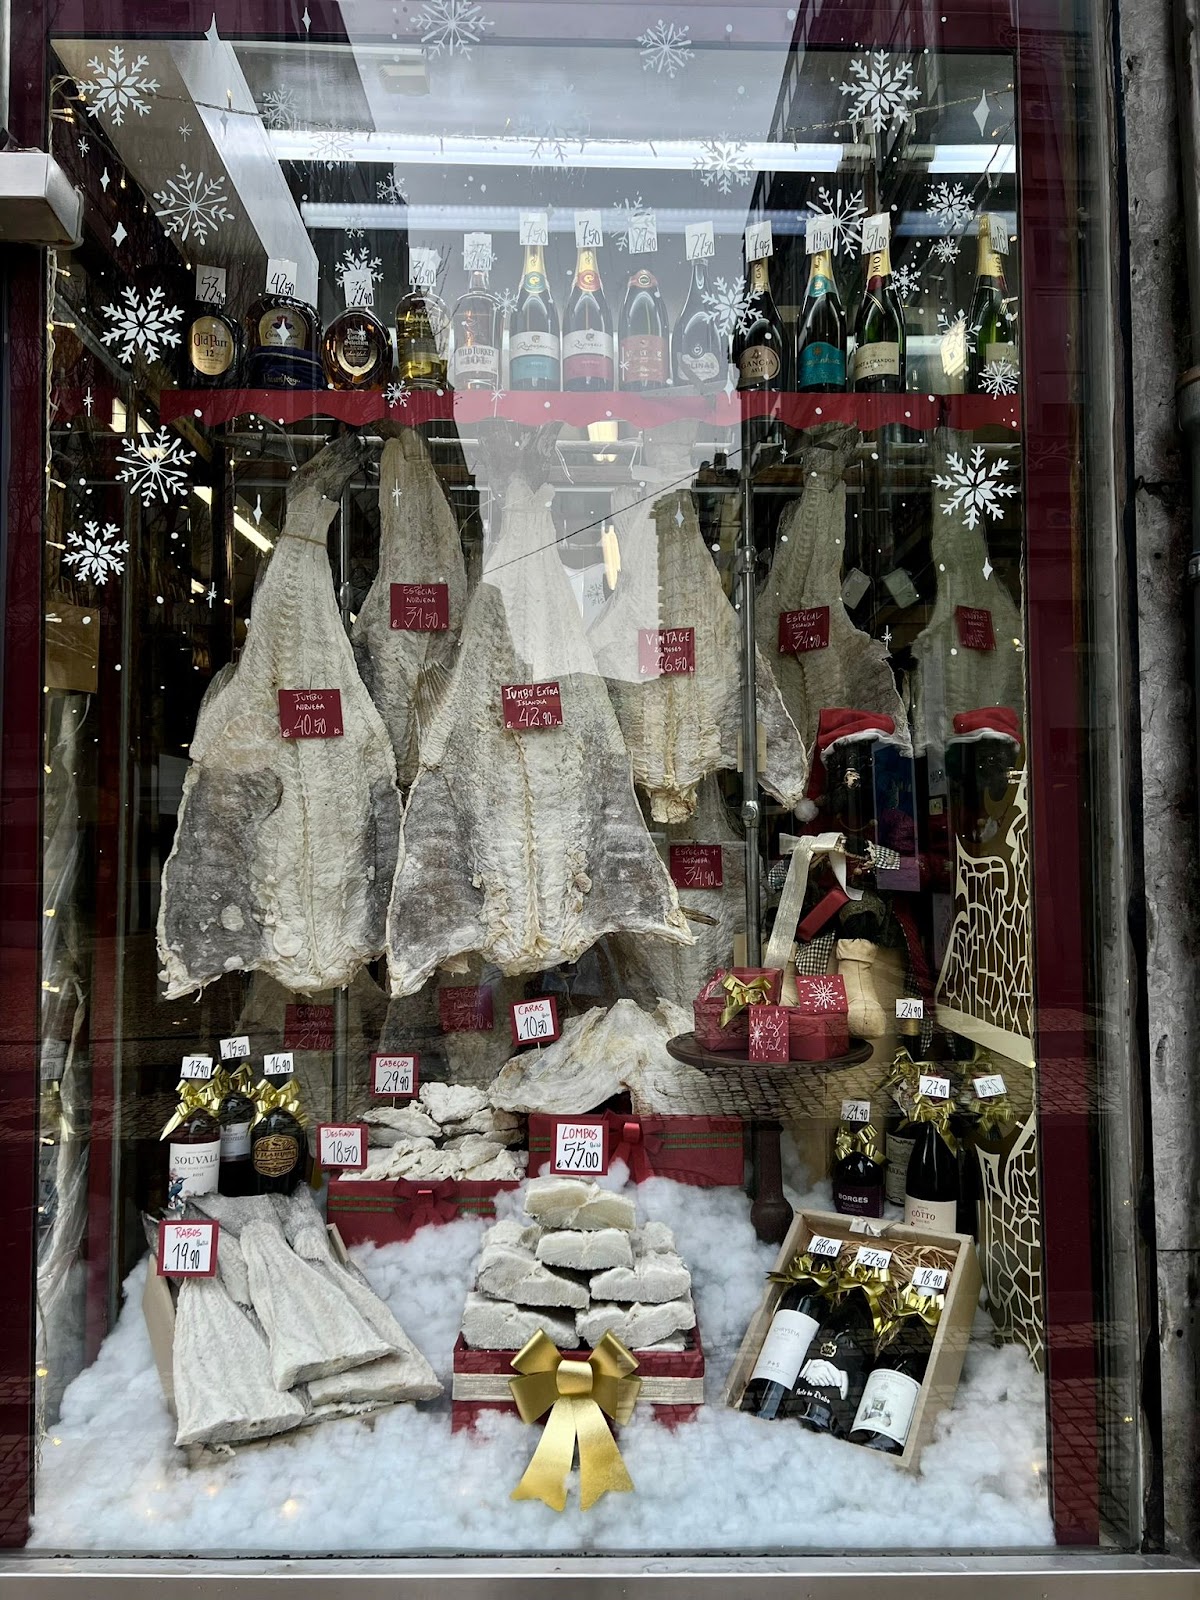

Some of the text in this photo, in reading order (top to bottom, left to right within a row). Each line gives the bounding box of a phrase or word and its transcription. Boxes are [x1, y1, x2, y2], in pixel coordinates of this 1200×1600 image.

[579, 221, 600, 246] 7.50
[194, 333, 208, 347] Old
[205, 349, 214, 357] 12
[293, 714, 327, 735] 40.50
[518, 1004, 545, 1015] CARAS
[523, 1016, 548, 1037] 10.50
[381, 1070, 409, 1092] 29.90
[562, 1126, 598, 1141] LOMBOS
[329, 1140, 358, 1163] 18.50
[563, 1140, 599, 1169] 55.00
[838, 1192, 869, 1204] BORGES
[174, 1226, 202, 1239] RABOS
[172, 1242, 200, 1270] 19.90
